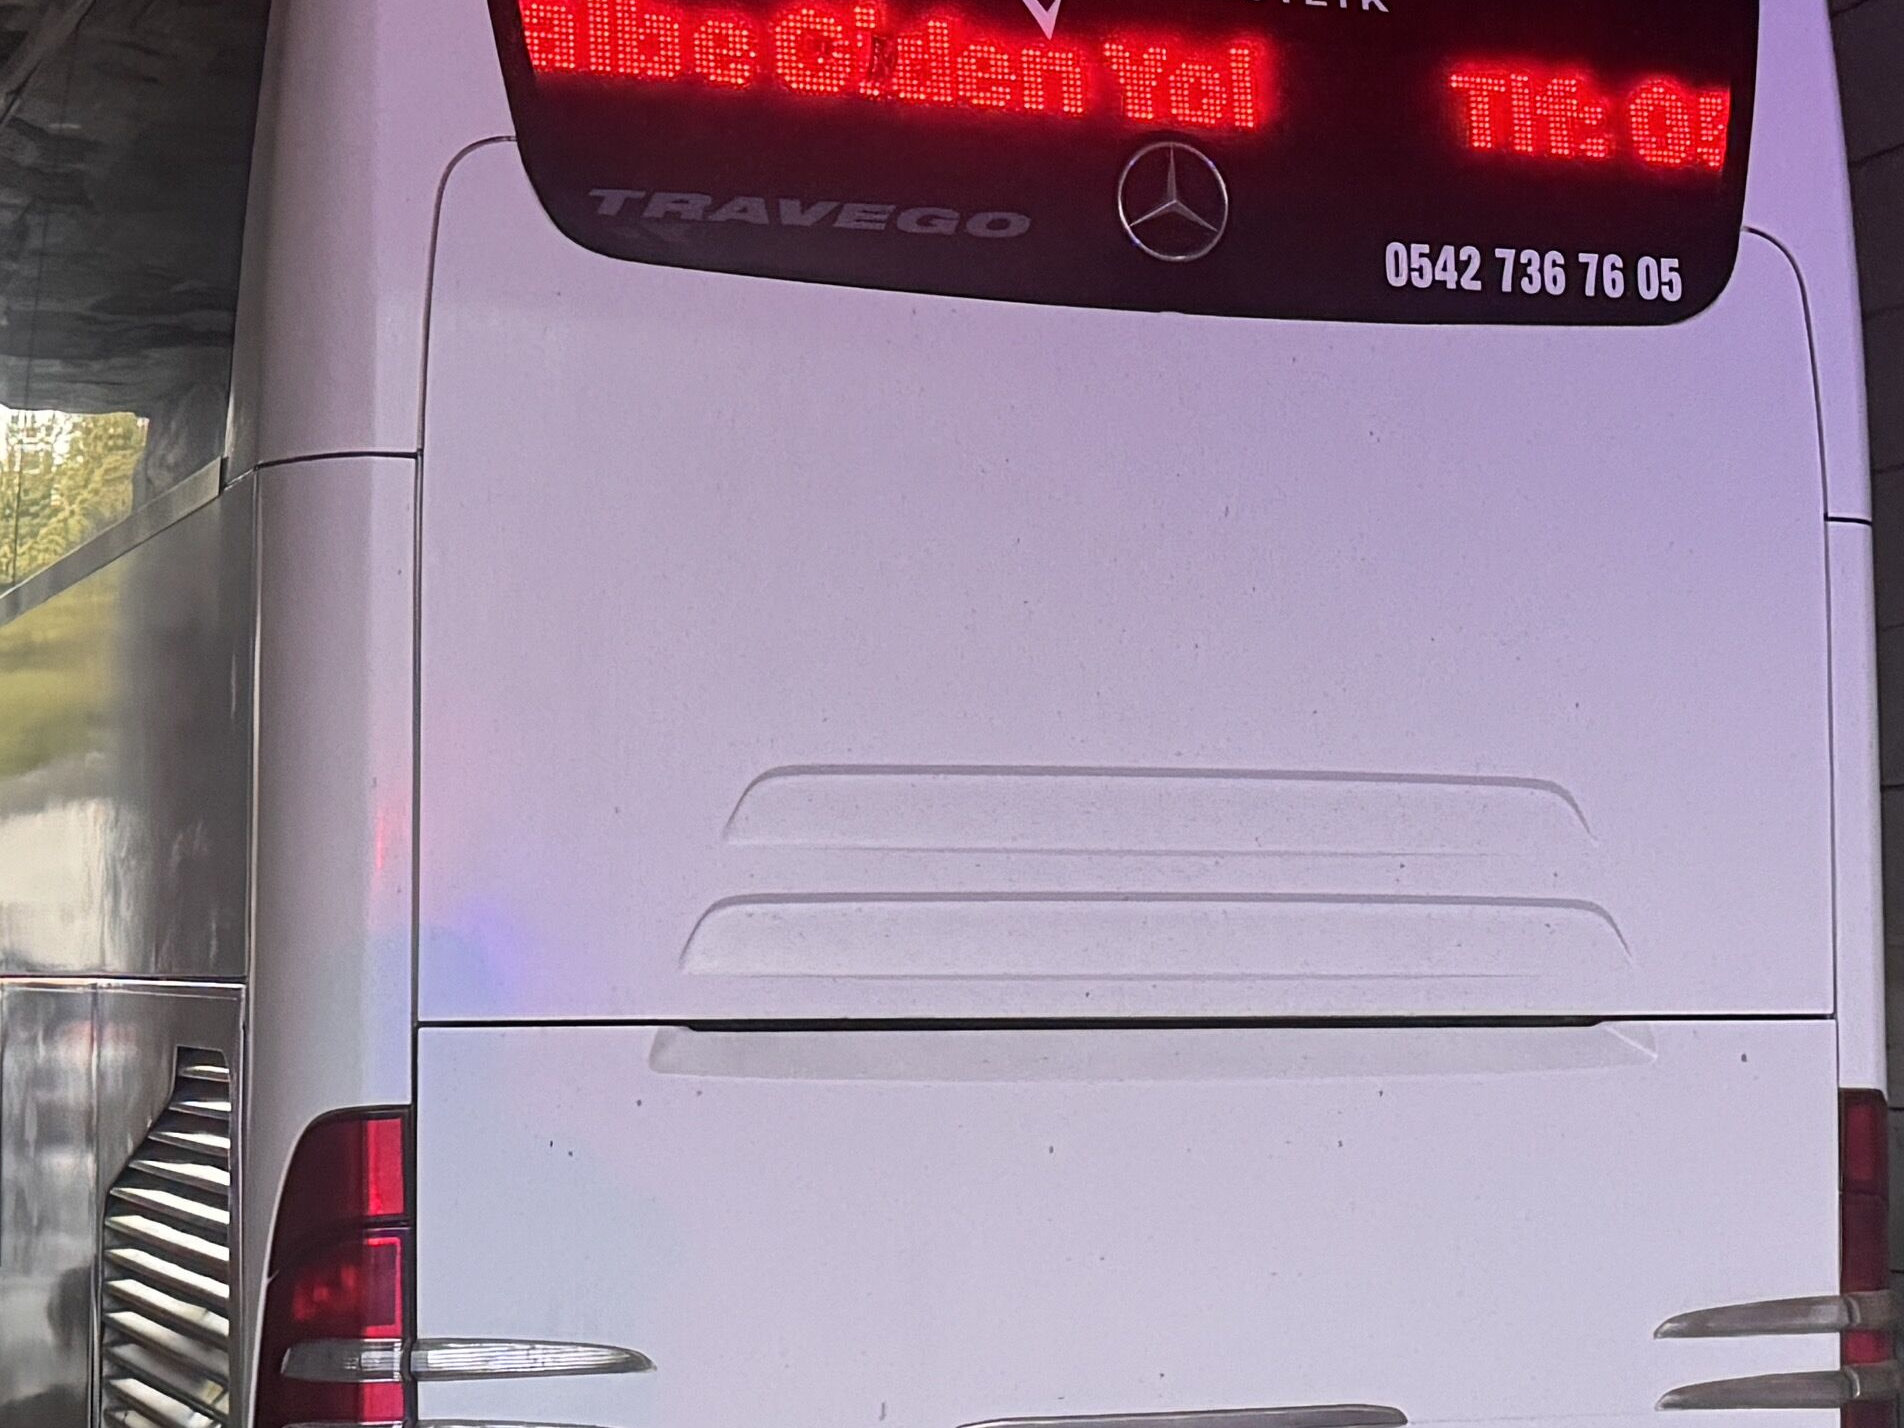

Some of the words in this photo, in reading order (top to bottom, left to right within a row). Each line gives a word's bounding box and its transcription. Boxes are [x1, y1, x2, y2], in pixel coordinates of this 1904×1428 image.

[1102, 41, 1256, 128] Yol
[588, 188, 1032, 239] TRAVEGO
[1385, 241, 1482, 291] 0542
[1495, 248, 1566, 296] 736
[1578, 253, 1625, 299] 76
[1637, 256, 1682, 302] 05
